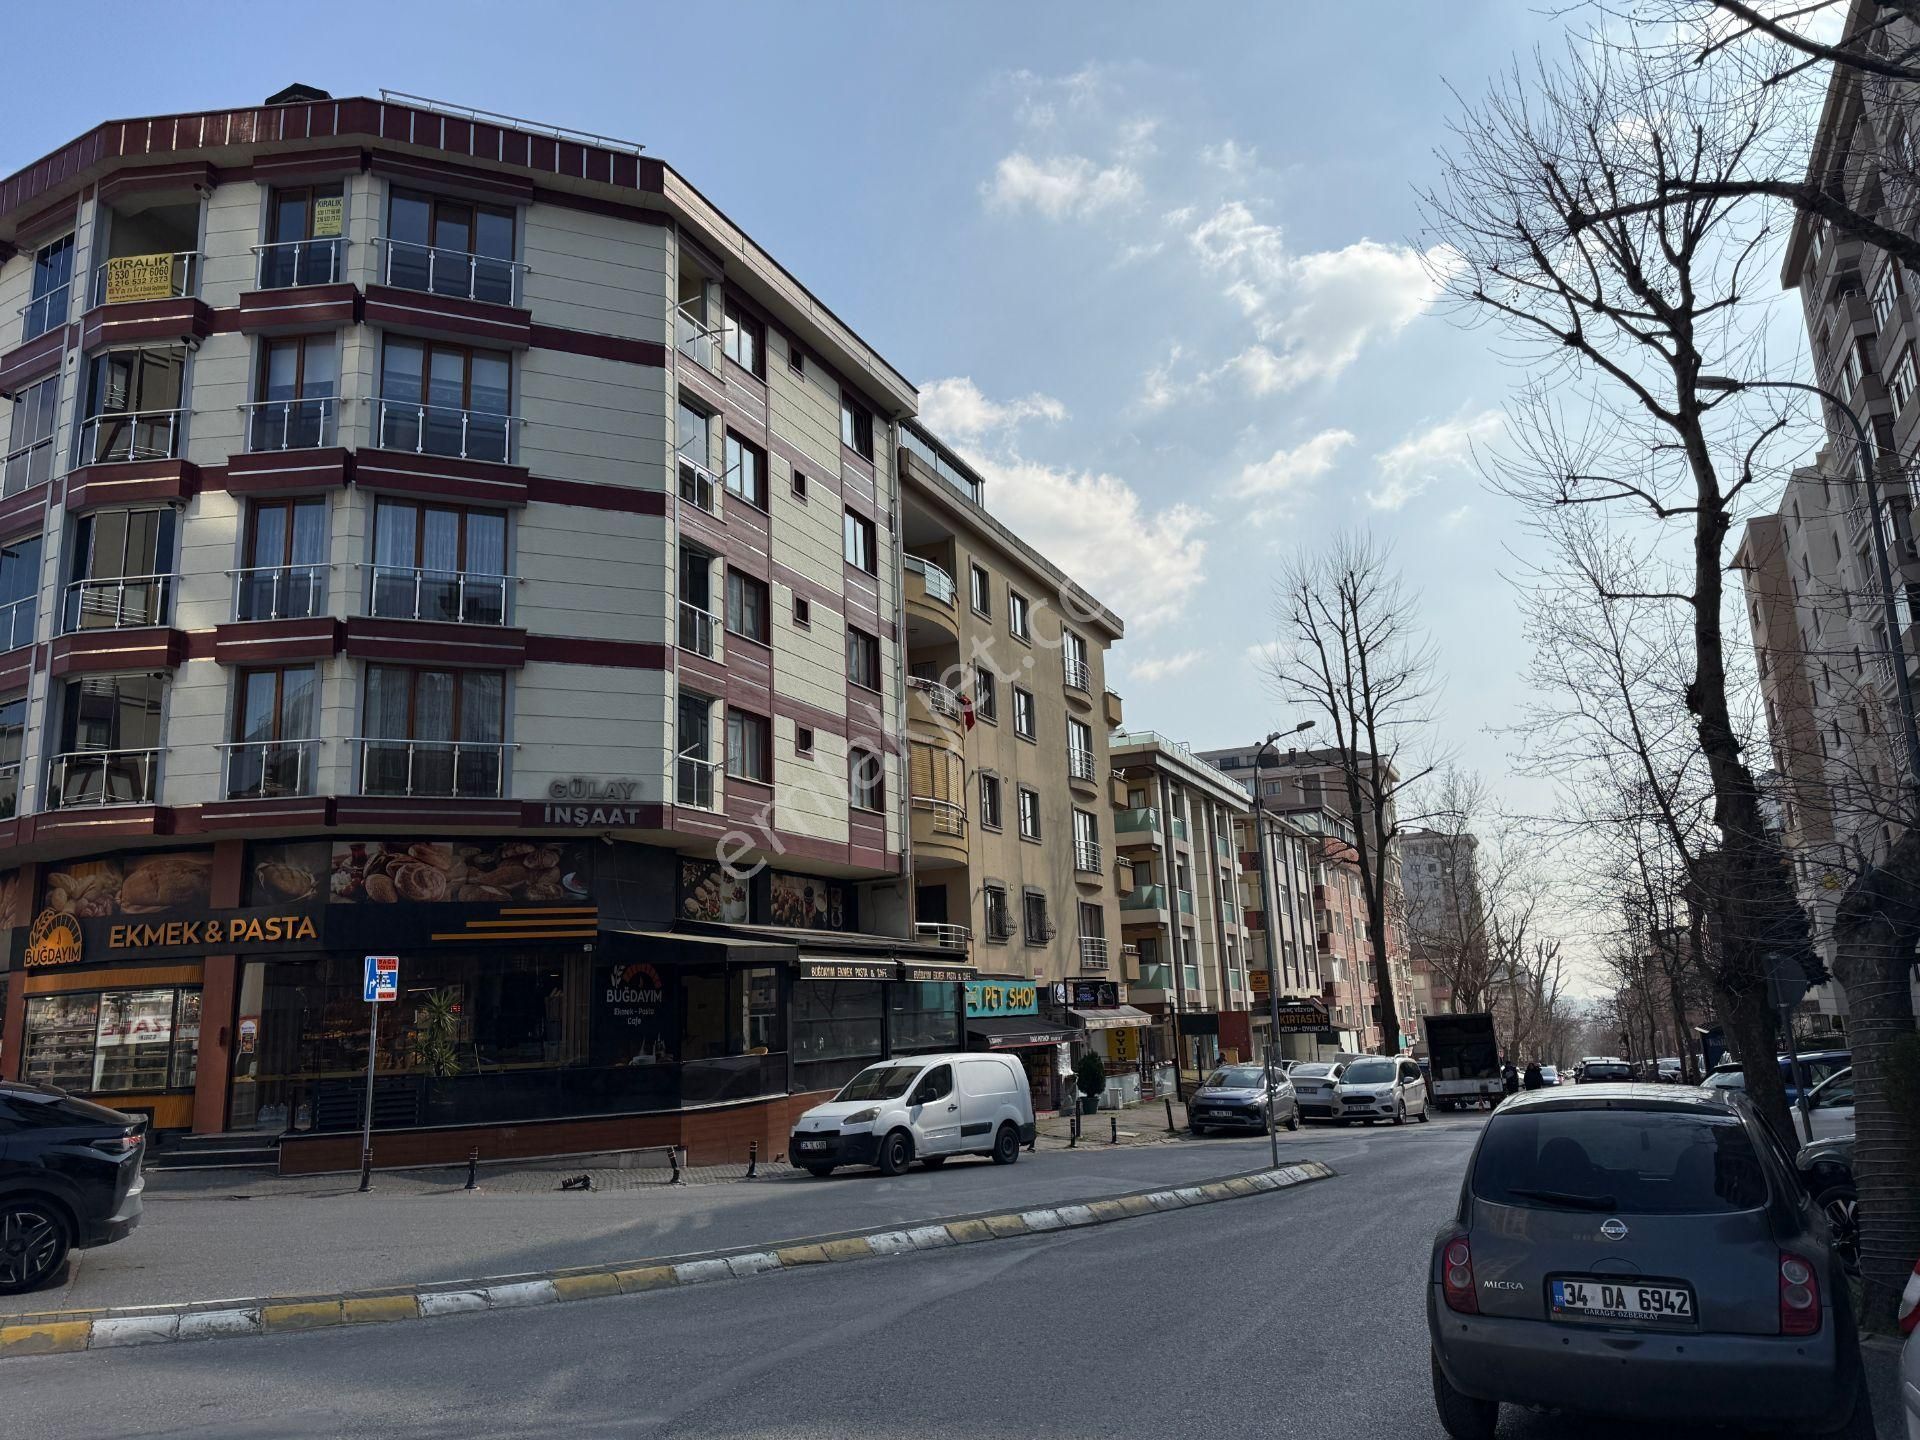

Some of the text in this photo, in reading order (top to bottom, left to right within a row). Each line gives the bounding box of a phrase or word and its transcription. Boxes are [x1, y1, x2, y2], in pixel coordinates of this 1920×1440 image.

[110, 256, 169, 270] KİRALIK
[108, 265, 169, 280] 0 530 177 6060
[150, 275, 168, 283] 7373
[549, 778, 636, 799] GÜLAY
[544, 802, 640, 828] İNŞAAT
[109, 916, 317, 948] EKMEK & PASTA
[25, 945, 81, 966] BUĞDAYIM
[606, 986, 662, 1003] BUĞDAYIM
[985, 986, 1036, 1009] PET SHOP
[1280, 1012, 1328, 1024] KIRTASİYE
[1484, 1280, 1524, 1290] MICRA
[1564, 1283, 1690, 1315] 34 DA 6942
[1584, 1308, 1616, 1317] GARAGE
